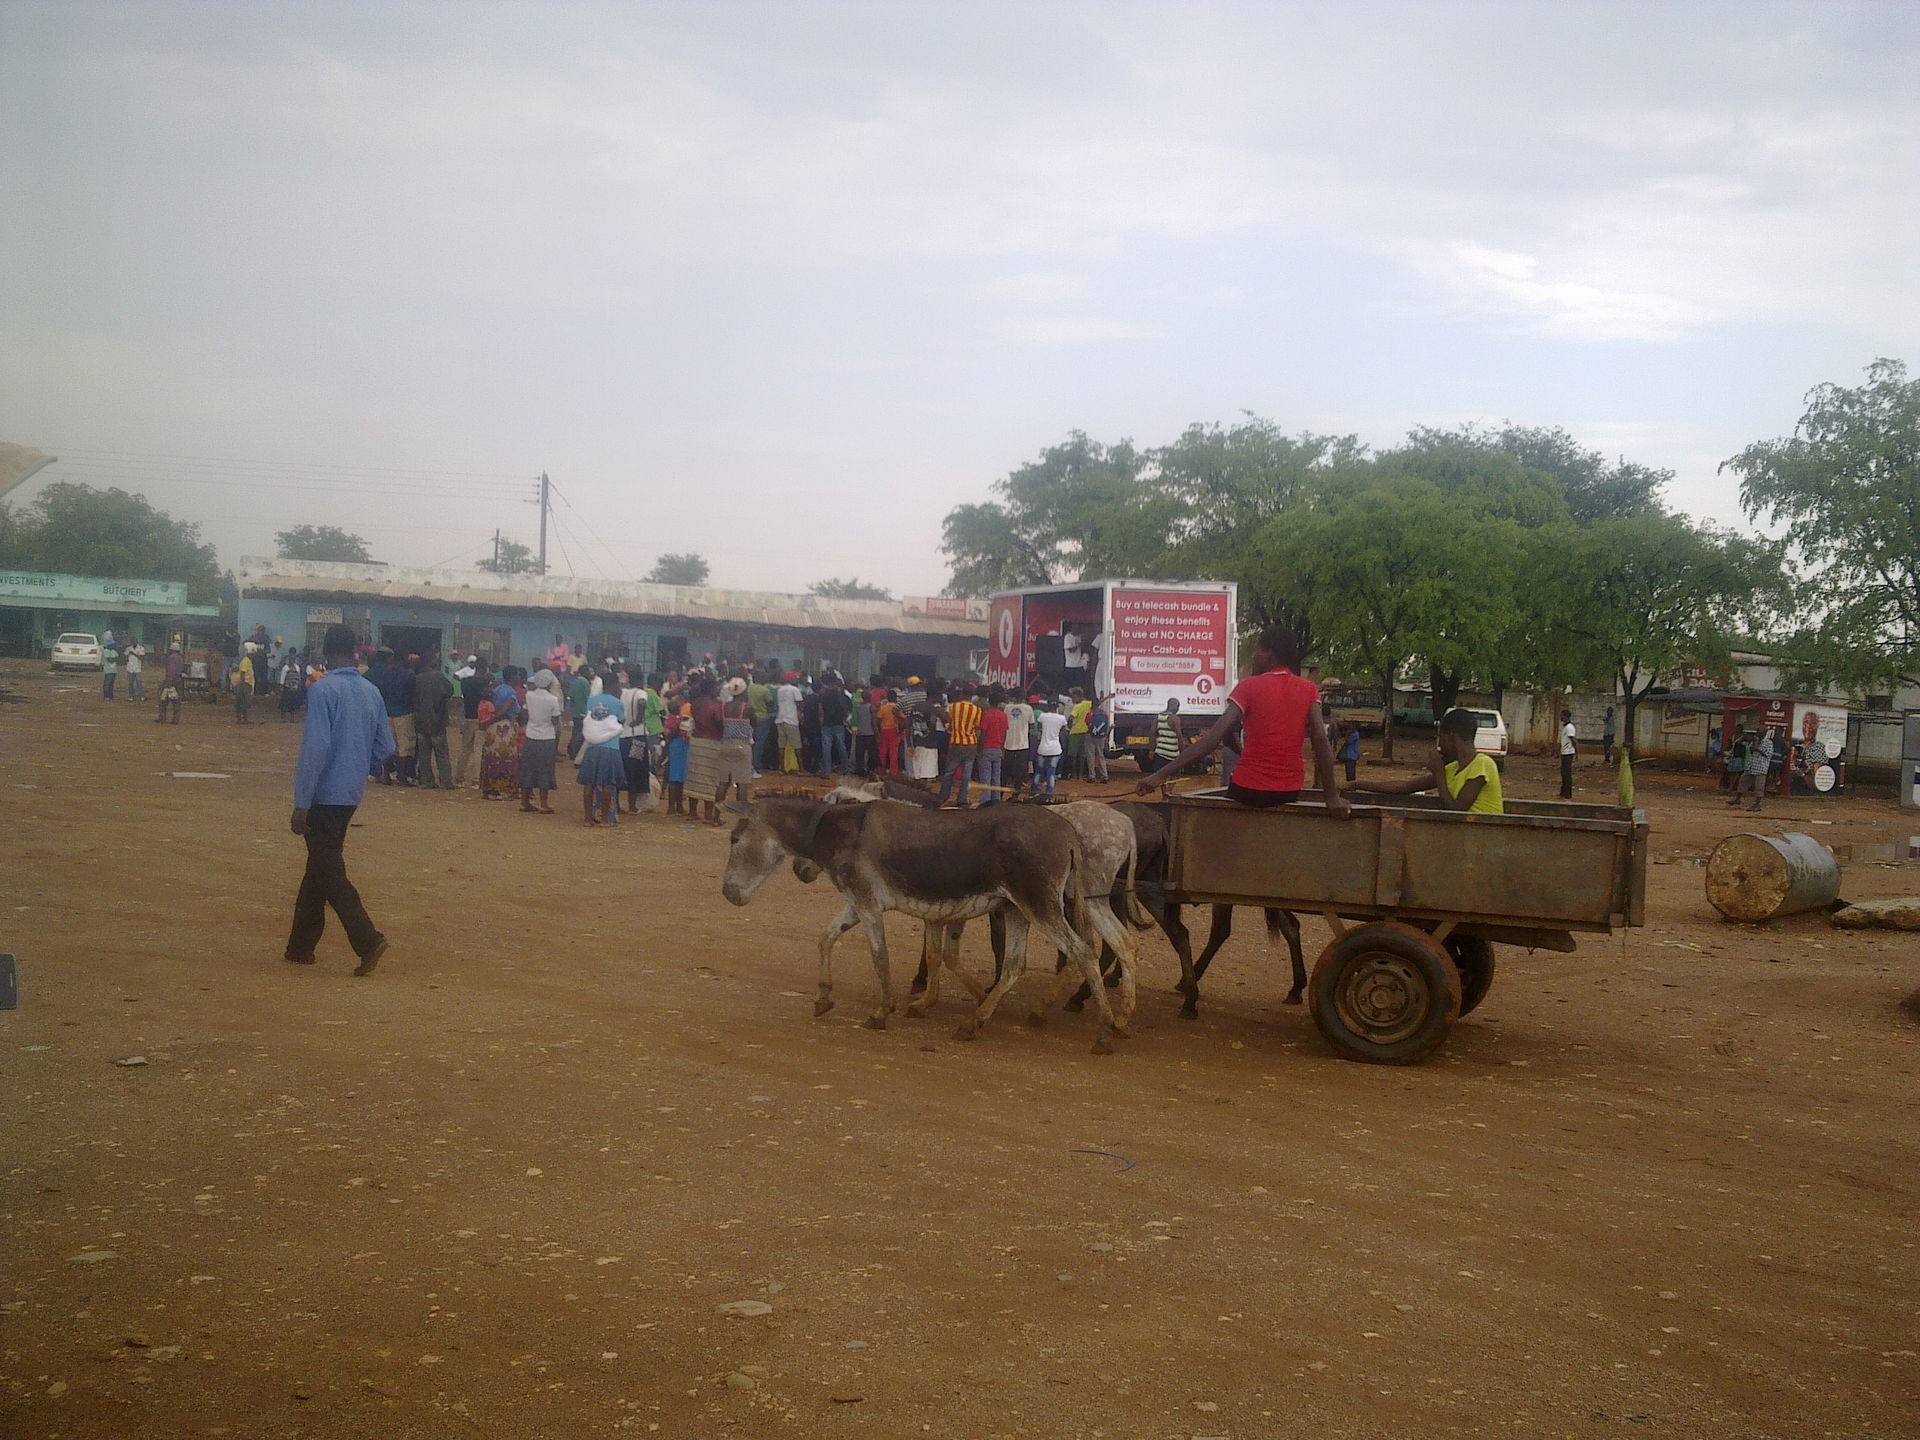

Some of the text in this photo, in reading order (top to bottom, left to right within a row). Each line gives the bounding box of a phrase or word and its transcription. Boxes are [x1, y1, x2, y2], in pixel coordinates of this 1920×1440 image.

[103, 586, 147, 597] BUTCHERY
[1116, 600, 1132, 610] Buy
[1142, 600, 1179, 610] telecash
[1181, 601, 1211, 611] bundle
[1213, 603, 1220, 611] &
[1125, 615, 1210, 625] enjoy these benefits
[1121, 629, 1130, 638] to
[1149, 631, 1159, 639] at
[1160, 631, 1175, 639] NO
[1176, 631, 1214, 640] CHARGE
[1146, 661, 1159, 669] buy
[988, 664, 1020, 689] telecel
[1116, 687, 1152, 697] telecash
[1187, 697, 1220, 706] telecel
